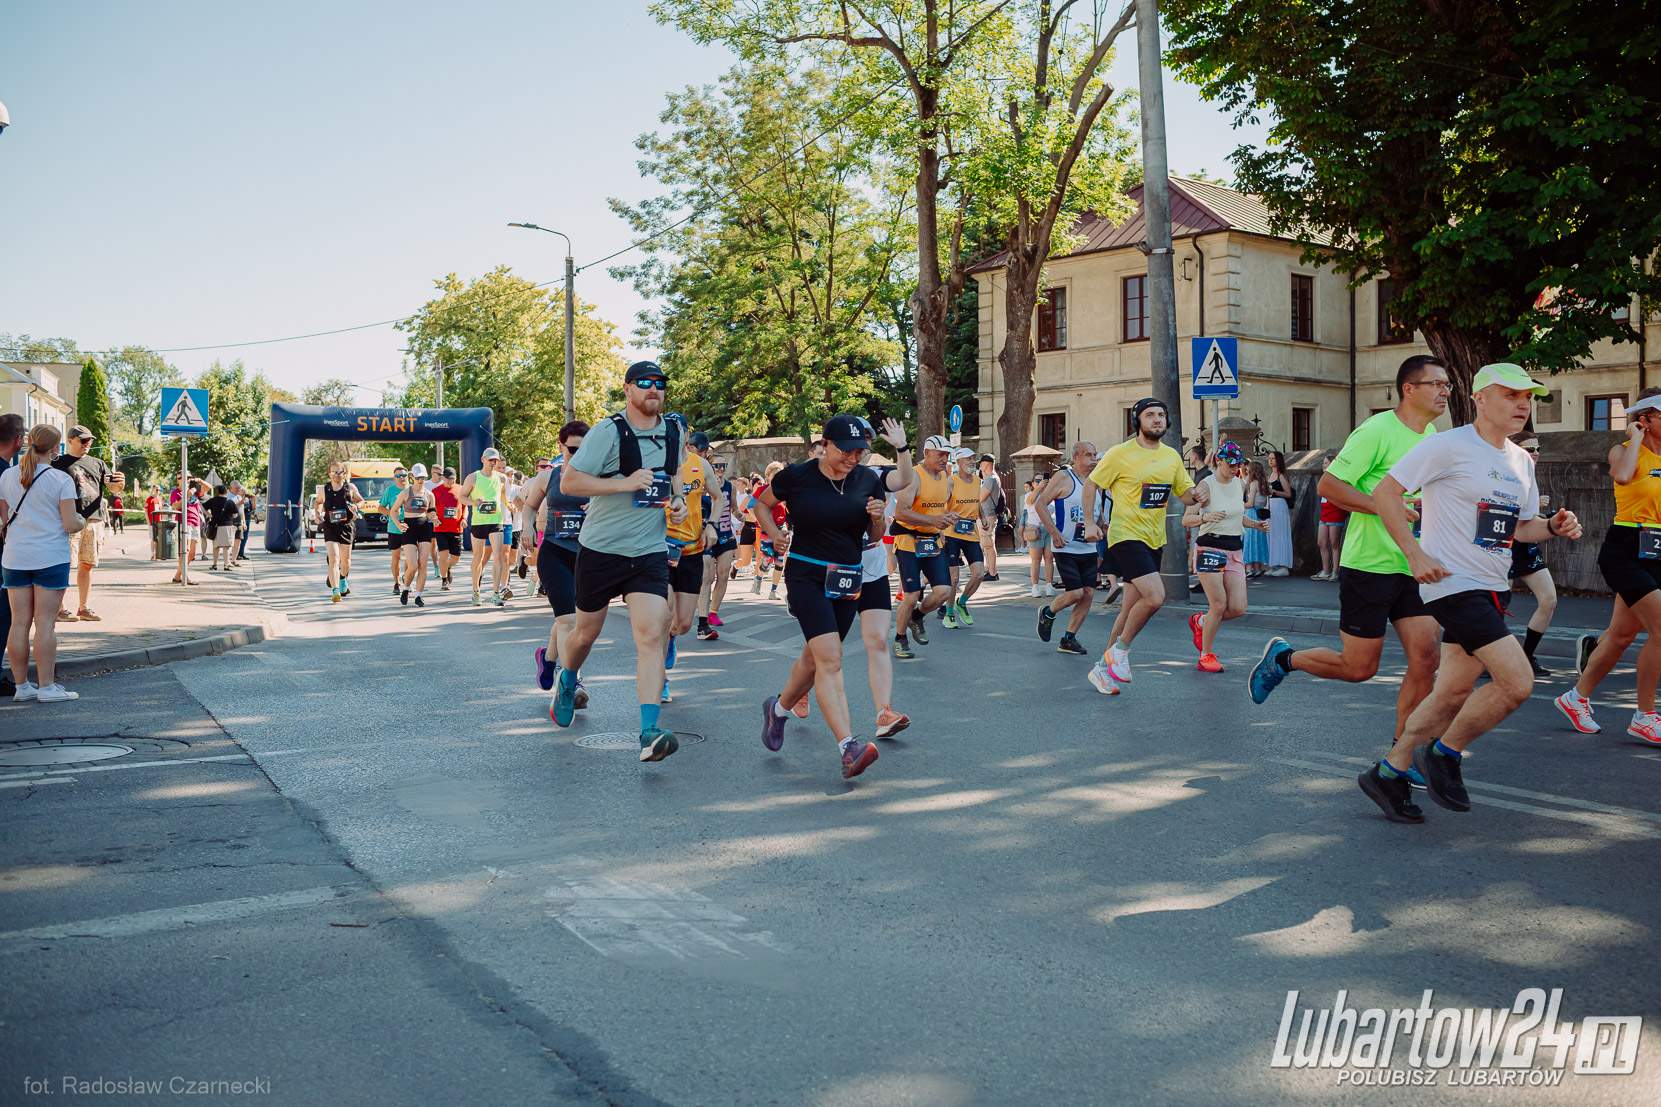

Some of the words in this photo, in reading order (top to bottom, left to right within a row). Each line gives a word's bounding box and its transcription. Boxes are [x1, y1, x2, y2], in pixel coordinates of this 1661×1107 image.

[357, 416, 417, 432] START
[849, 423, 860, 437] LA
[645, 486, 659, 497] 92
[1149, 492, 1165, 501] 107
[562, 520, 580, 529] 134
[1493, 519, 1506, 534] 81
[924, 543, 934, 551] 86
[1653, 539, 1661, 549] 2
[1203, 557, 1220, 566] 125
[838, 577, 853, 589] 80
